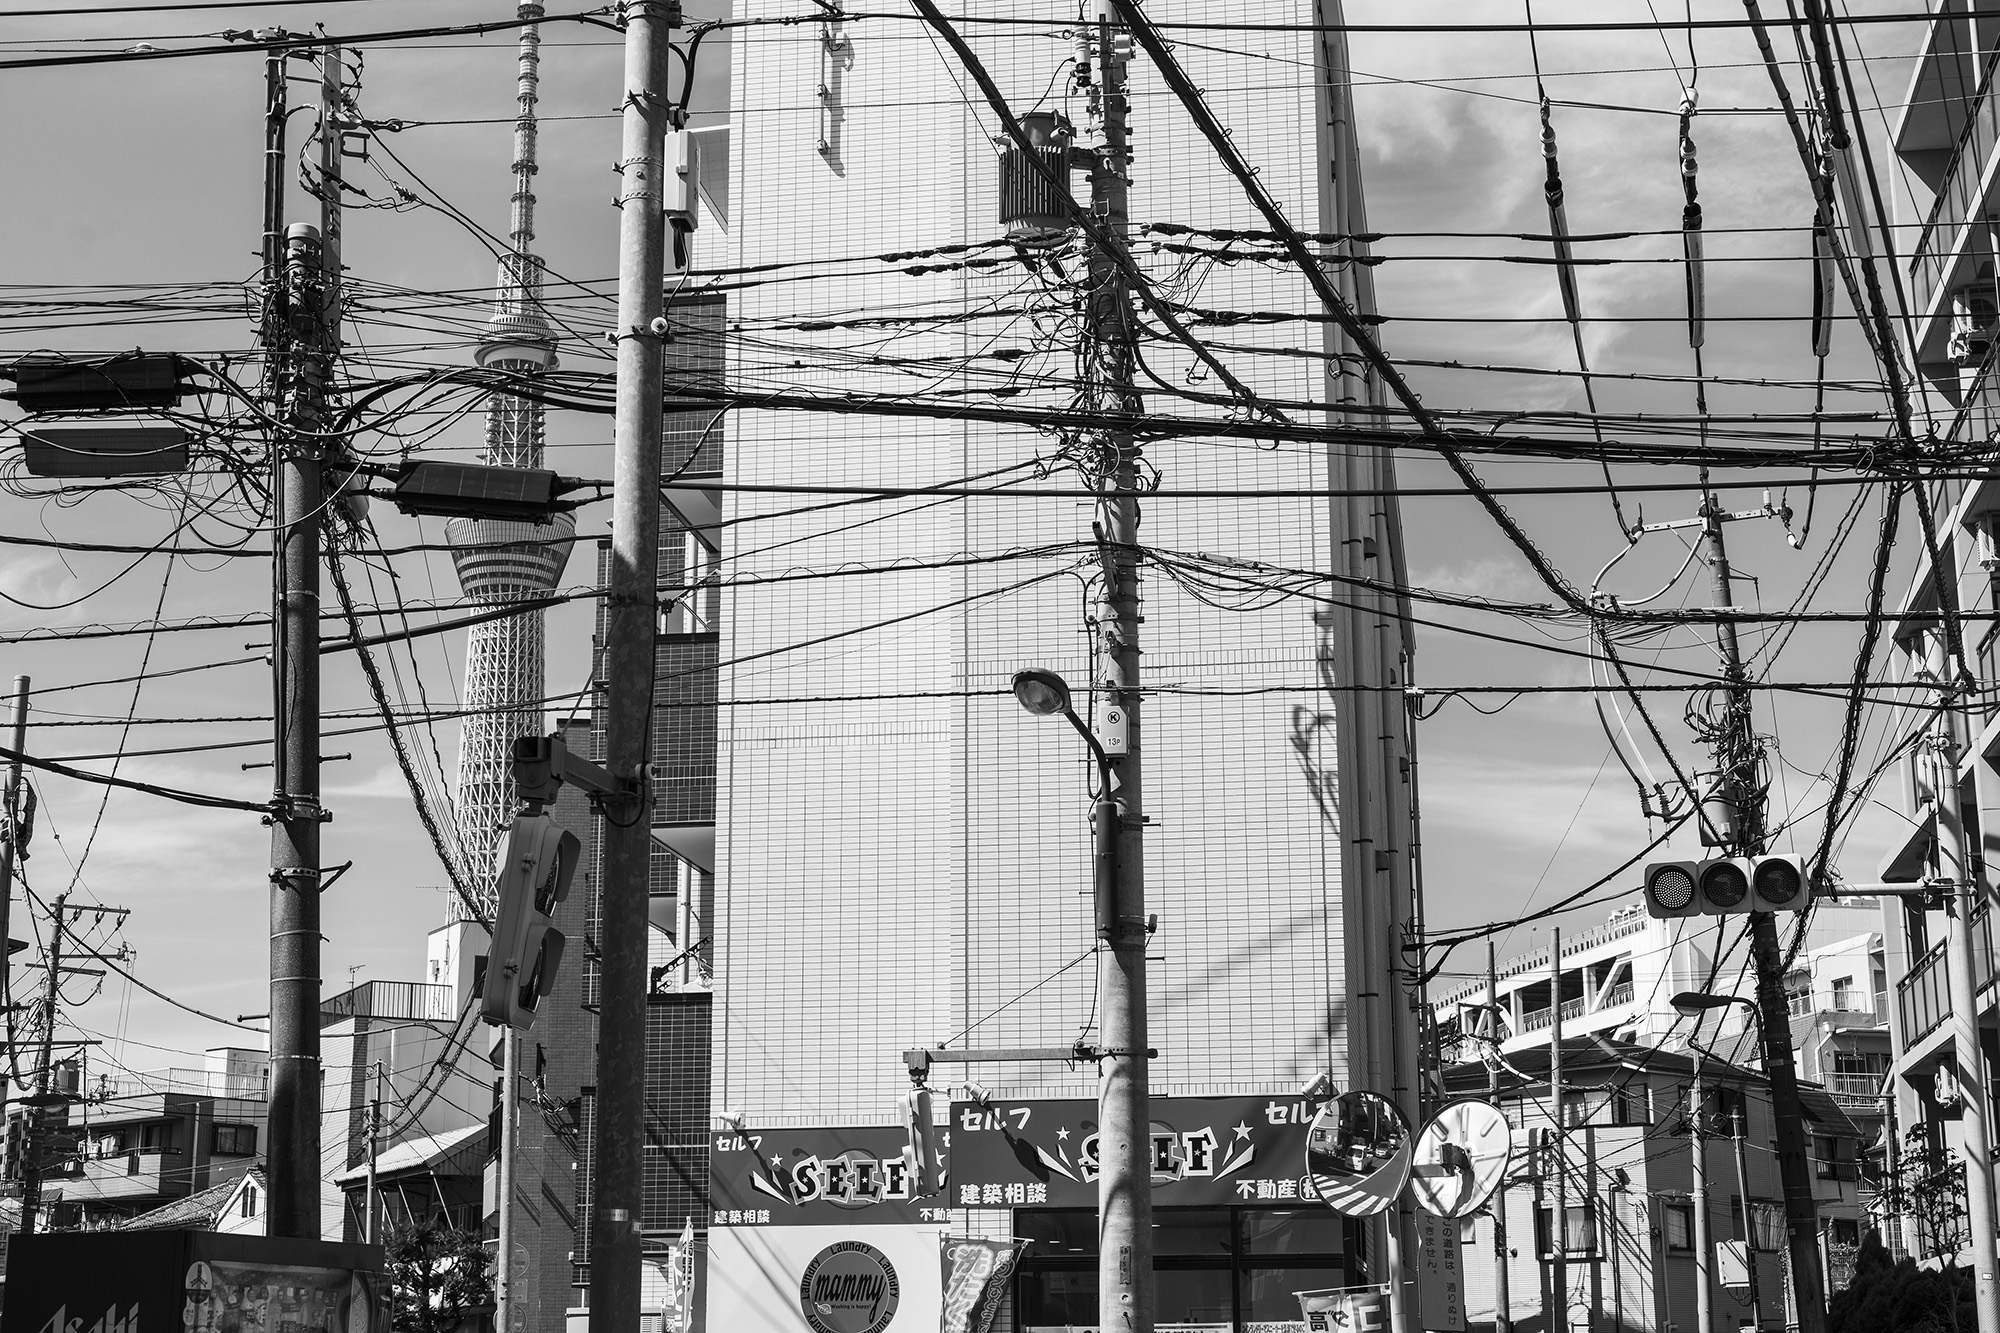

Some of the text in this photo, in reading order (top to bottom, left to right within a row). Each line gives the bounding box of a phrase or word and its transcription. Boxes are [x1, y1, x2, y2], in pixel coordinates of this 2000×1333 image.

[960, 1107, 1031, 1131] セルフ
[716, 1136, 762, 1152] セルフ
[789, 1155, 909, 1204] SELF
[960, 1183, 1047, 1205] 建築相談
[714, 1210, 770, 1224] 建築相談
[830, 1242, 872, 1255] Laundry
[1425, 1215, 1438, 1275] できません。
[802, 1258, 821, 1299] Laundry
[878, 1256, 899, 1299] Laundry
[814, 1274, 887, 1324] mammy
